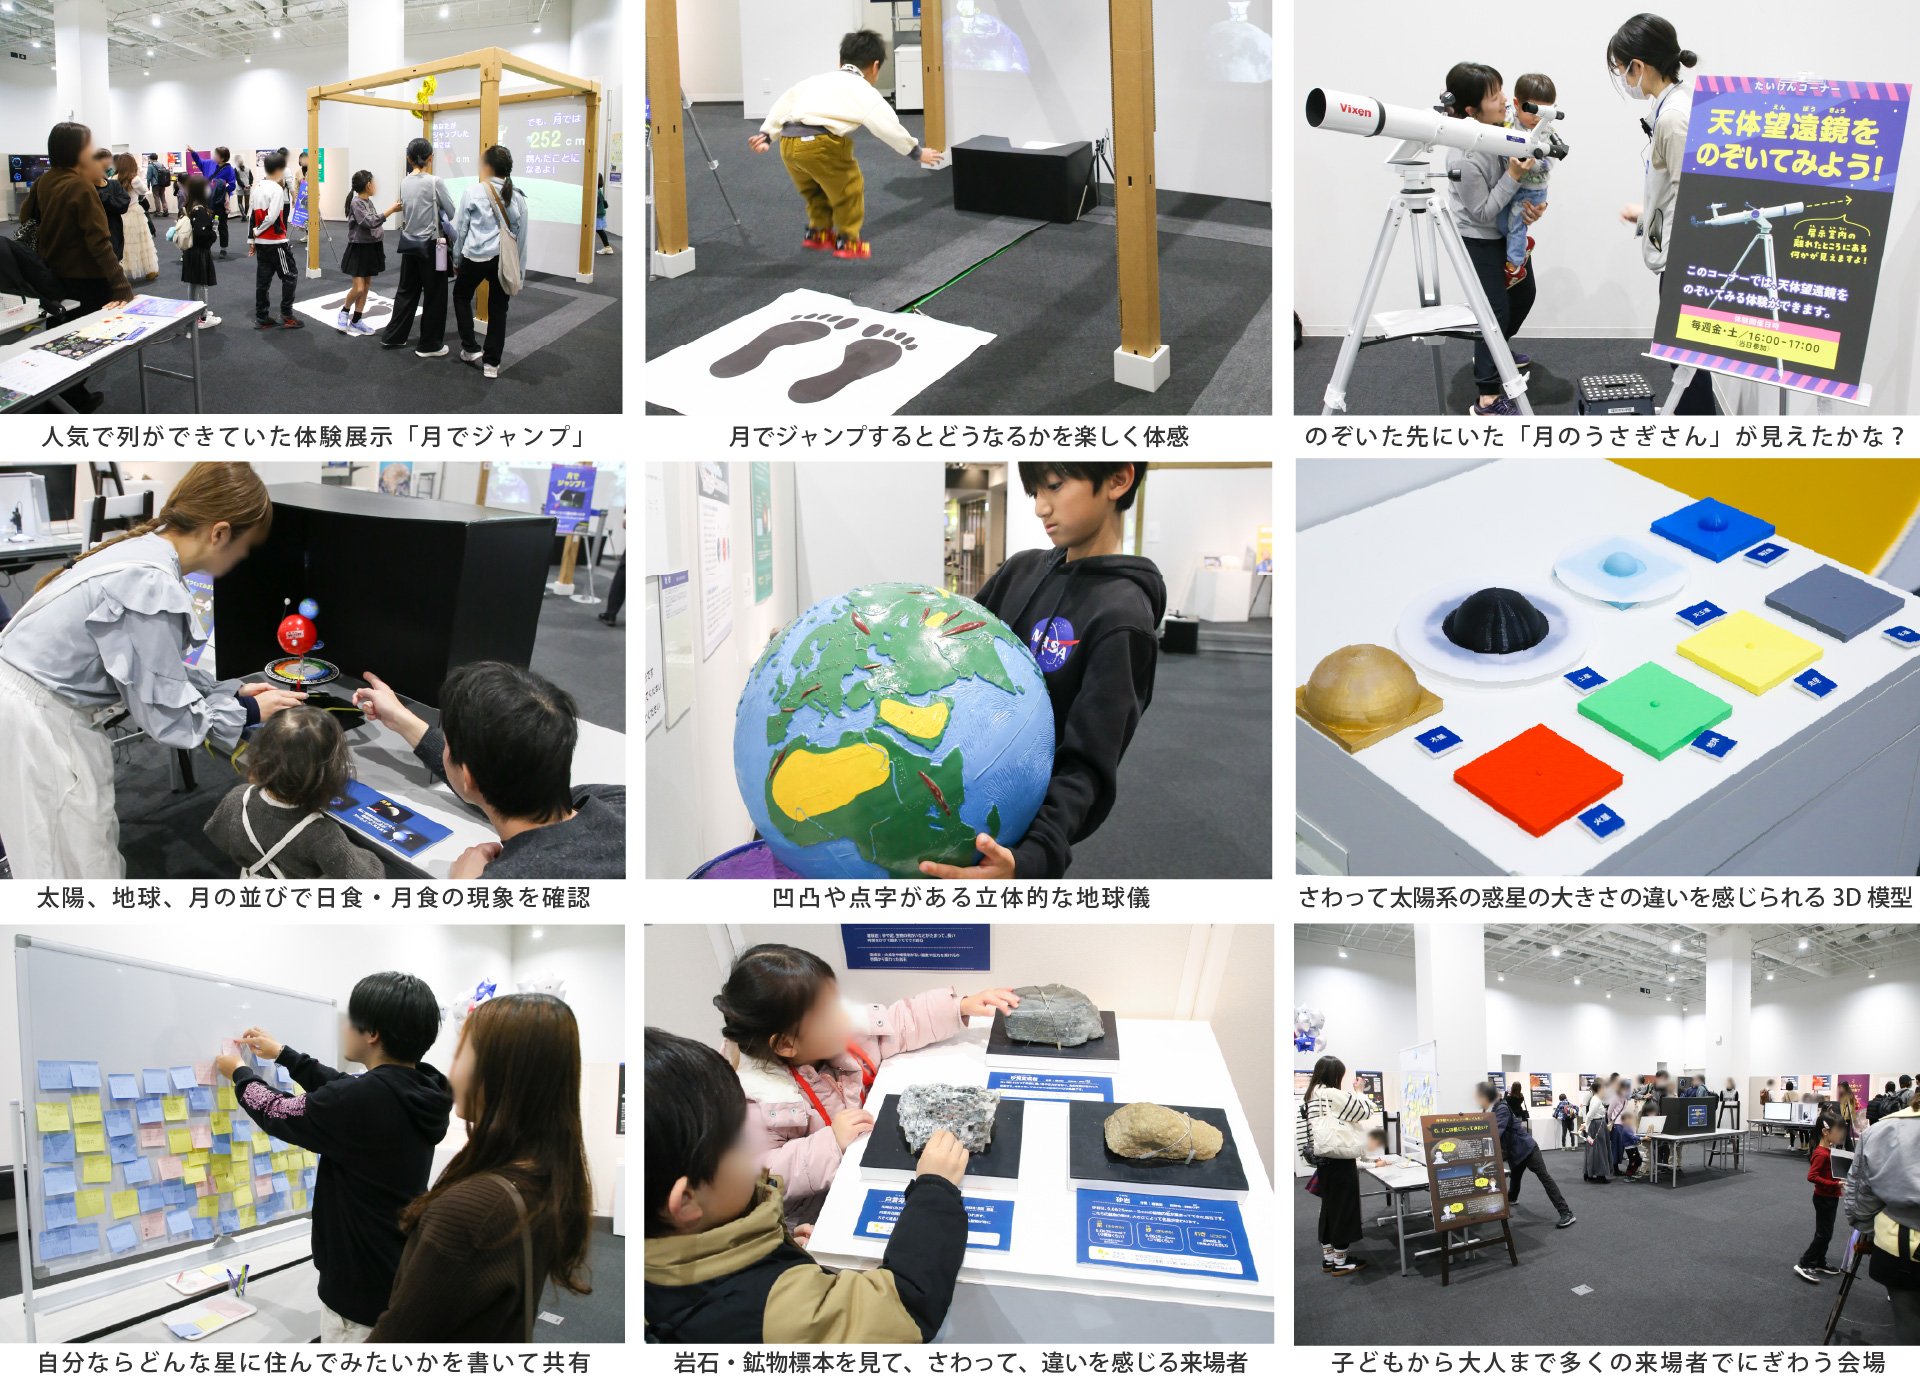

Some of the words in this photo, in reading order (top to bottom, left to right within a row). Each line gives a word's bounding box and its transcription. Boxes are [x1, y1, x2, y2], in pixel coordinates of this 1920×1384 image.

[1754, 81, 1841, 92] たいけんコーナー
[1339, 102, 1372, 118] Vixen
[432, 130, 470, 139] ジャンプした
[1707, 108, 1880, 146] 天体望遠鏡を
[1696, 142, 1884, 182] のぞいてみよう!
[1793, 238, 1867, 253] 離れたところにある
[1807, 228, 1856, 240] 展示室内の
[1686, 264, 1849, 302] このコーナーでは、天体望遠鏡を
[1683, 284, 1832, 319] のぞいてみる体験ができます。
[1031, 628, 1067, 661] NASA
